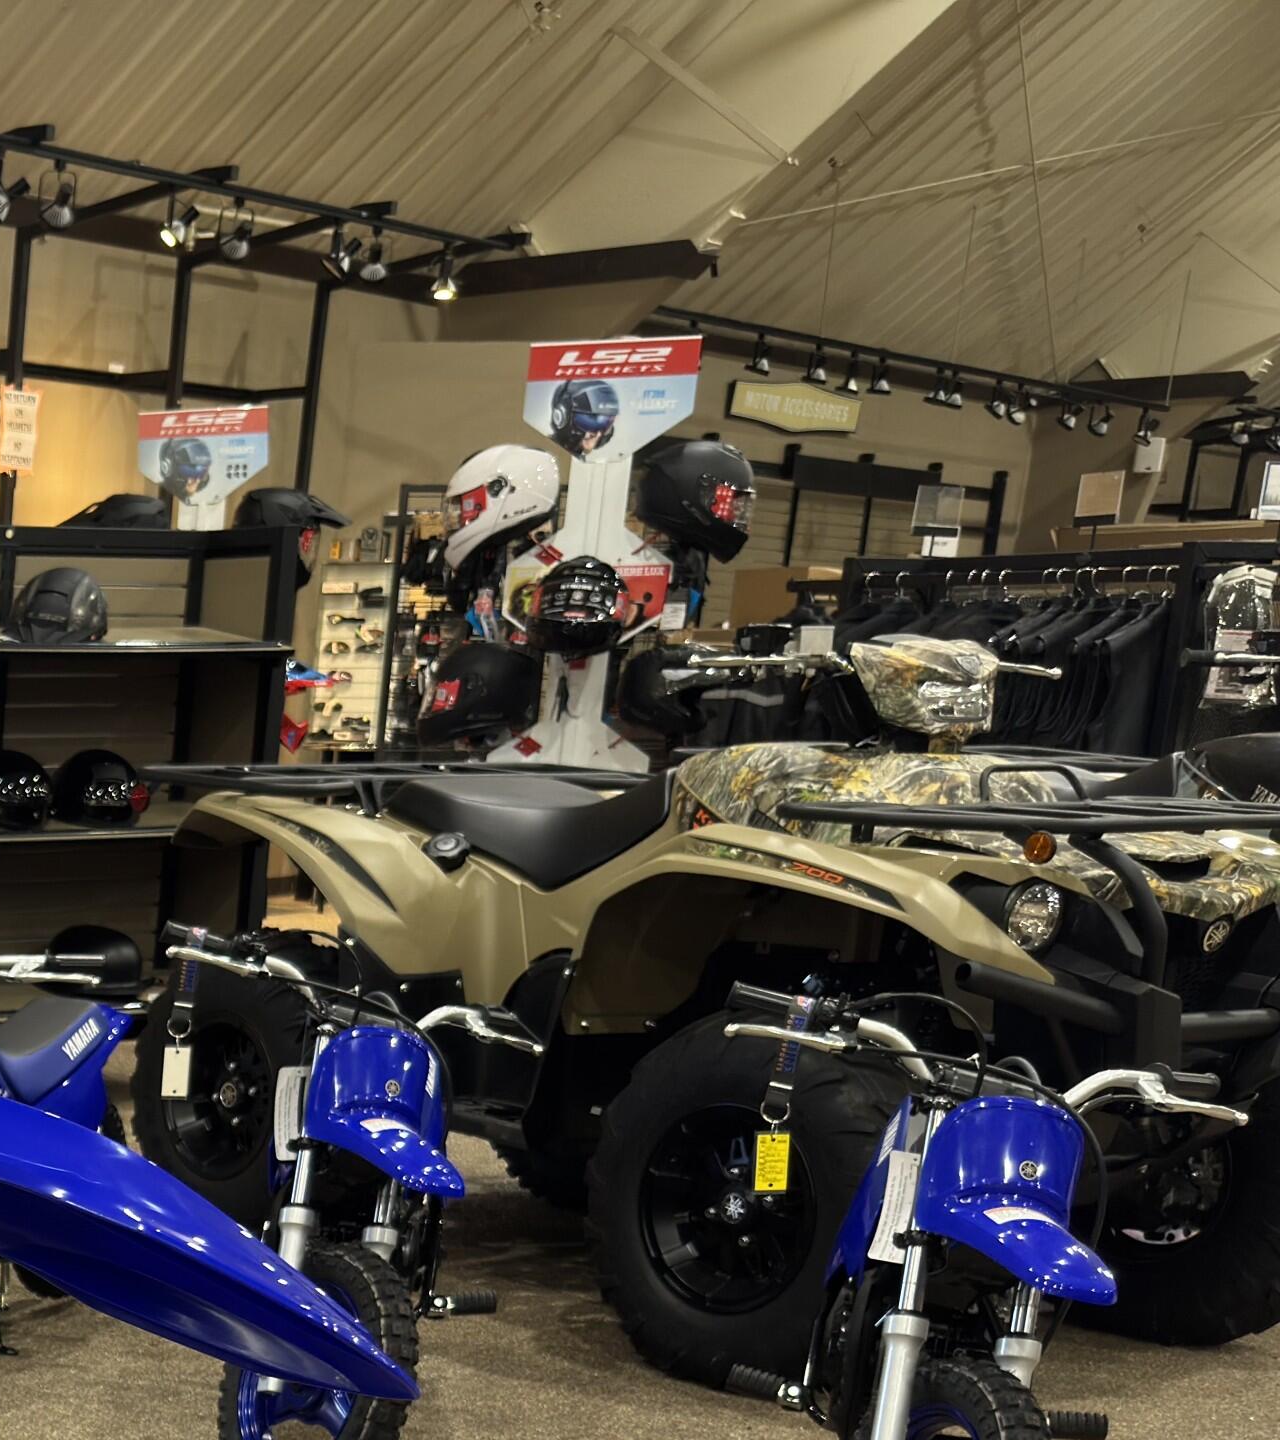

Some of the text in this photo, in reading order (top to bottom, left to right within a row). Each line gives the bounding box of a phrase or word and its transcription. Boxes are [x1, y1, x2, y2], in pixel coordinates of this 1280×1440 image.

[558, 346, 673, 367] LS2
[555, 364, 665, 377] HELMETS
[744, 391, 782, 413] MOTOR
[161, 411, 249, 429] LS2
[791, 861, 845, 886] 700
[61, 1016, 102, 1061] YAMAHA
